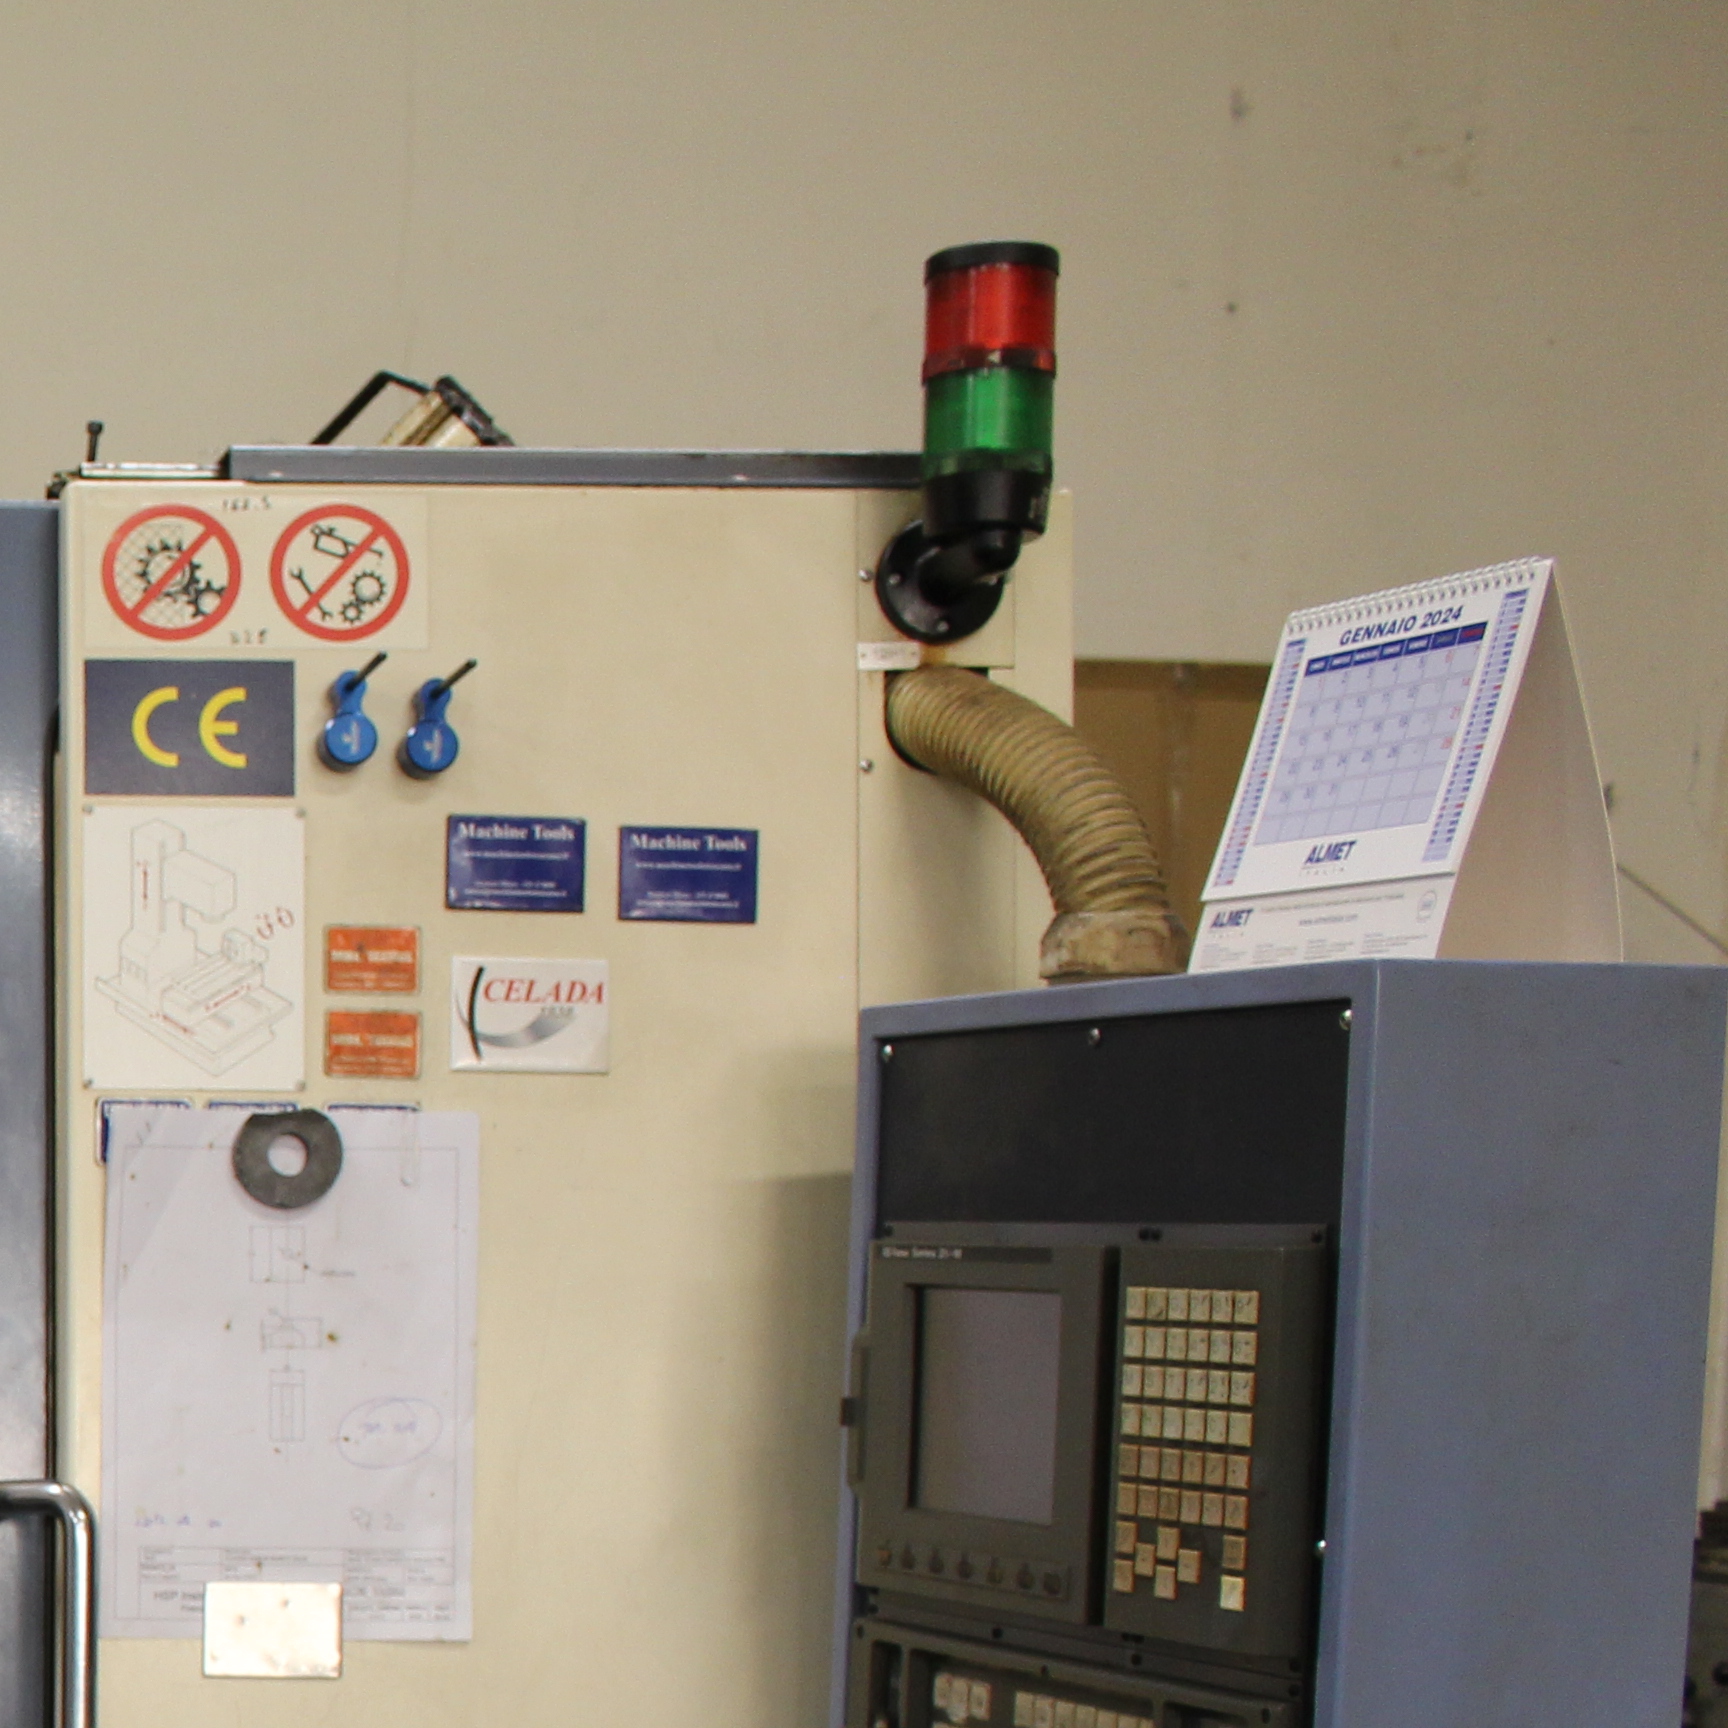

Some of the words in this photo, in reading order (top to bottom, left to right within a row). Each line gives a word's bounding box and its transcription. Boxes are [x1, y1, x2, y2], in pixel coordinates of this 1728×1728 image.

[1339, 616, 1418, 646] GENNAIO
[1420, 606, 1464, 631] 2024
[458, 822, 527, 840] Machine
[532, 824, 576, 841] Tools
[630, 834, 701, 851] Machine
[705, 835, 747, 852] Tools
[1304, 840, 1358, 866] ALMET
[1210, 908, 1255, 928] ALMET
[483, 980, 605, 1004] CELADA
